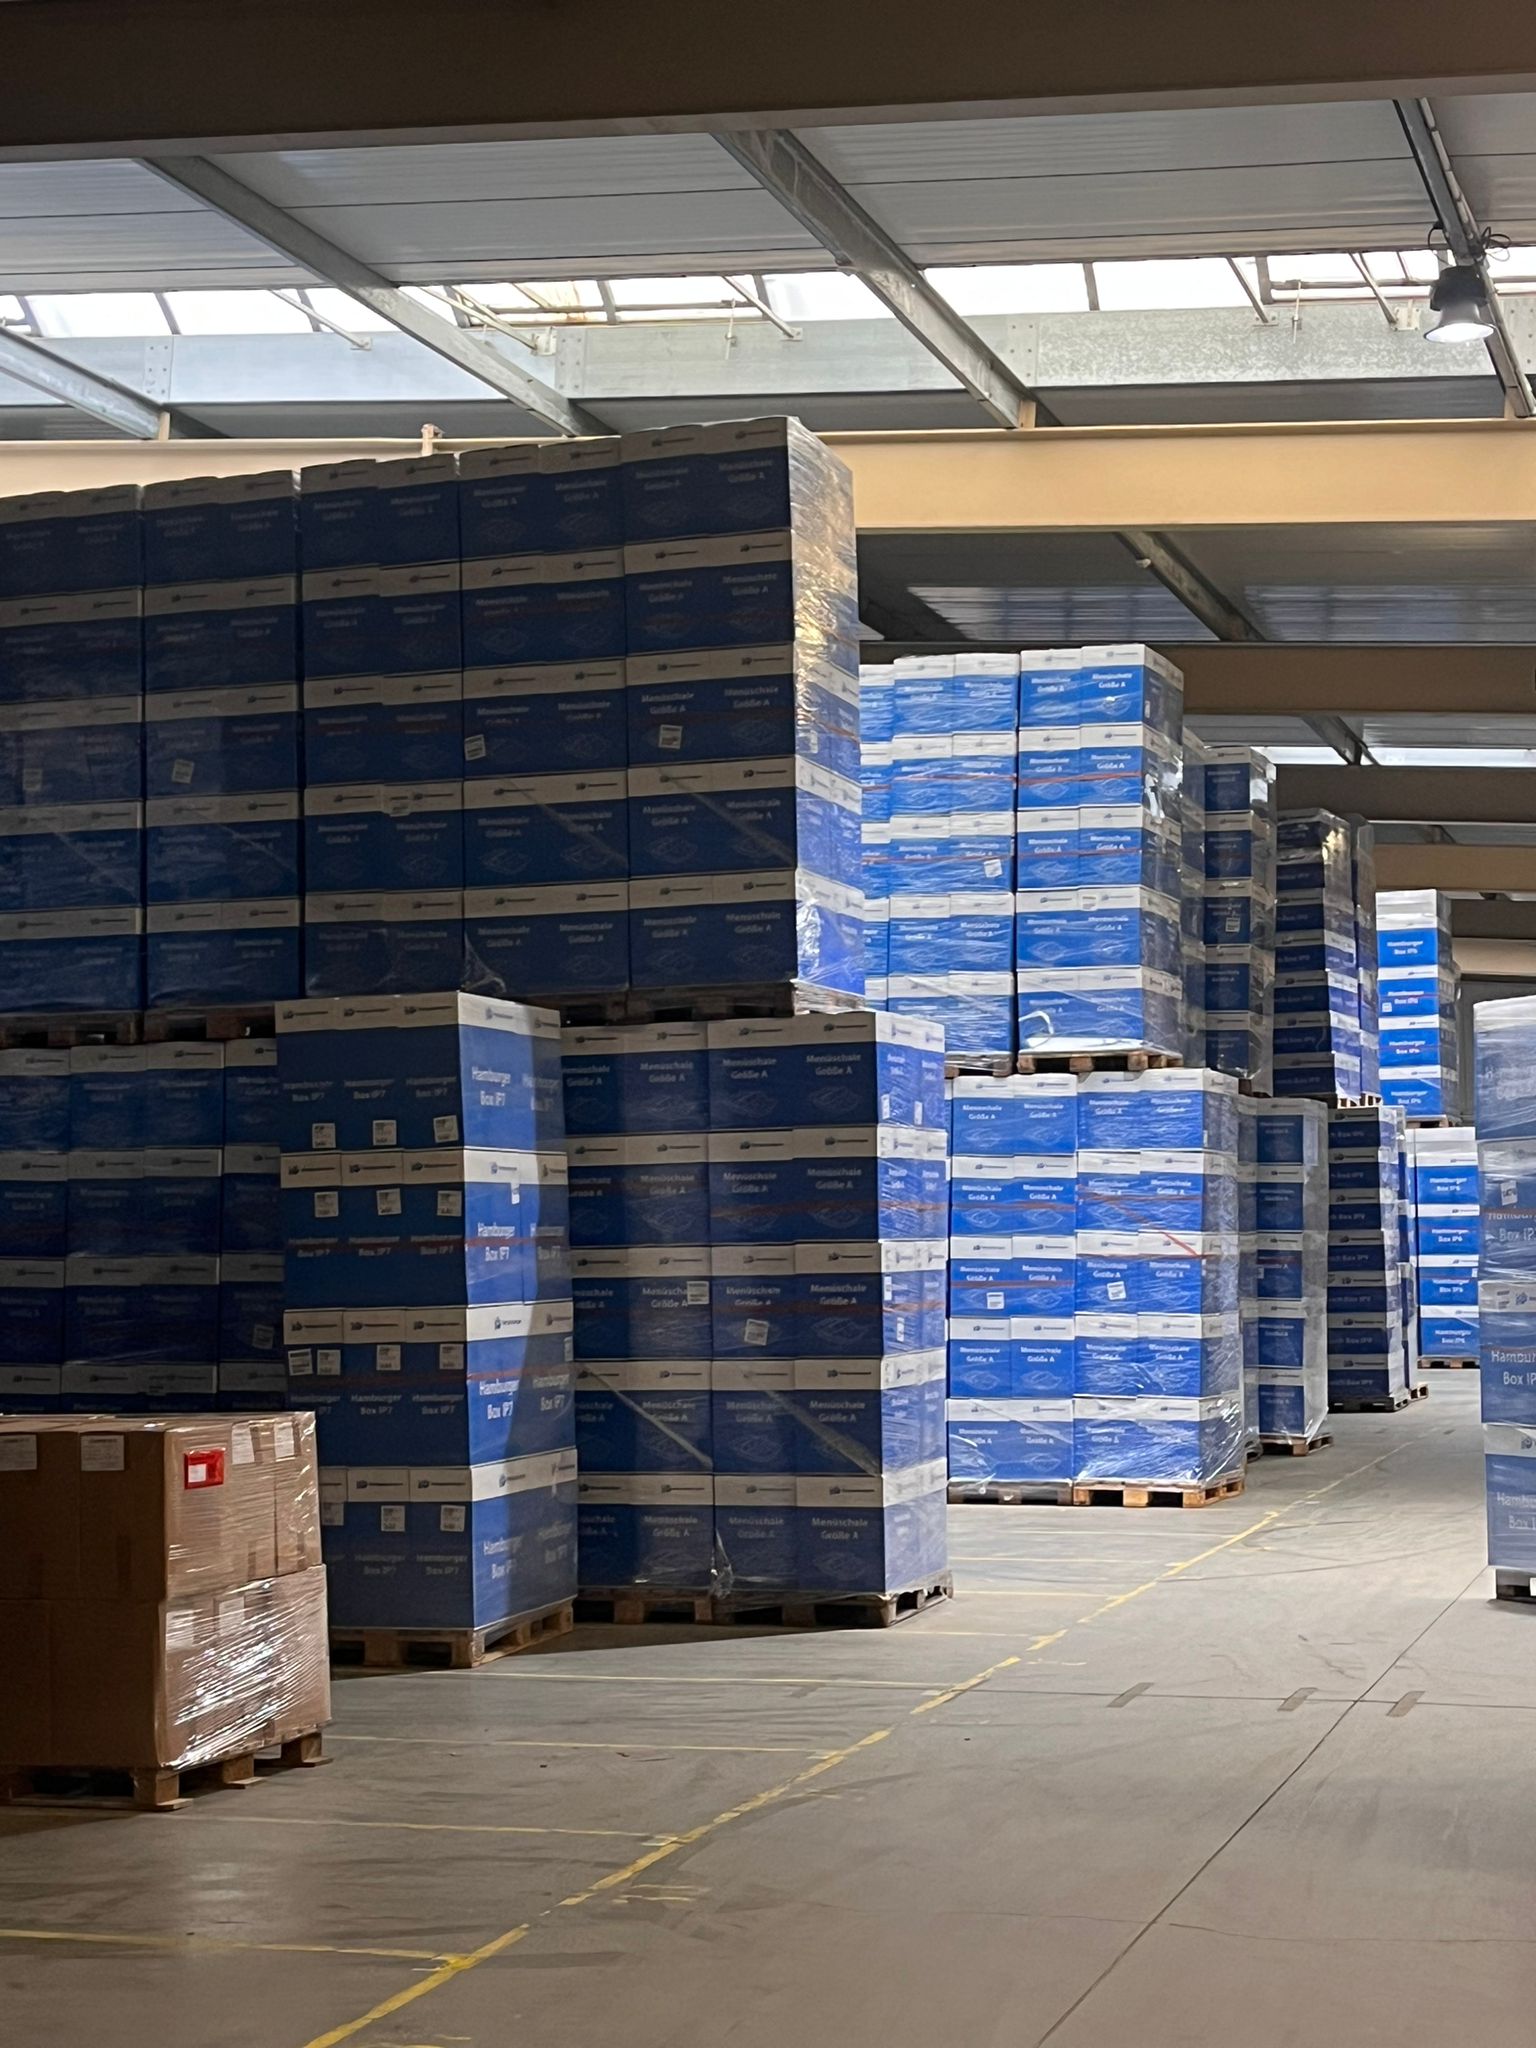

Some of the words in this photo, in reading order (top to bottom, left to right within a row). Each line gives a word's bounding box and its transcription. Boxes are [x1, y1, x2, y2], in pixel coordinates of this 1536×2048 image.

[1504, 1372, 1524, 1385] Box
[360, 1406, 378, 1415] Box
[422, 1405, 439, 1414] Box
[488, 1403, 501, 1420] Box
